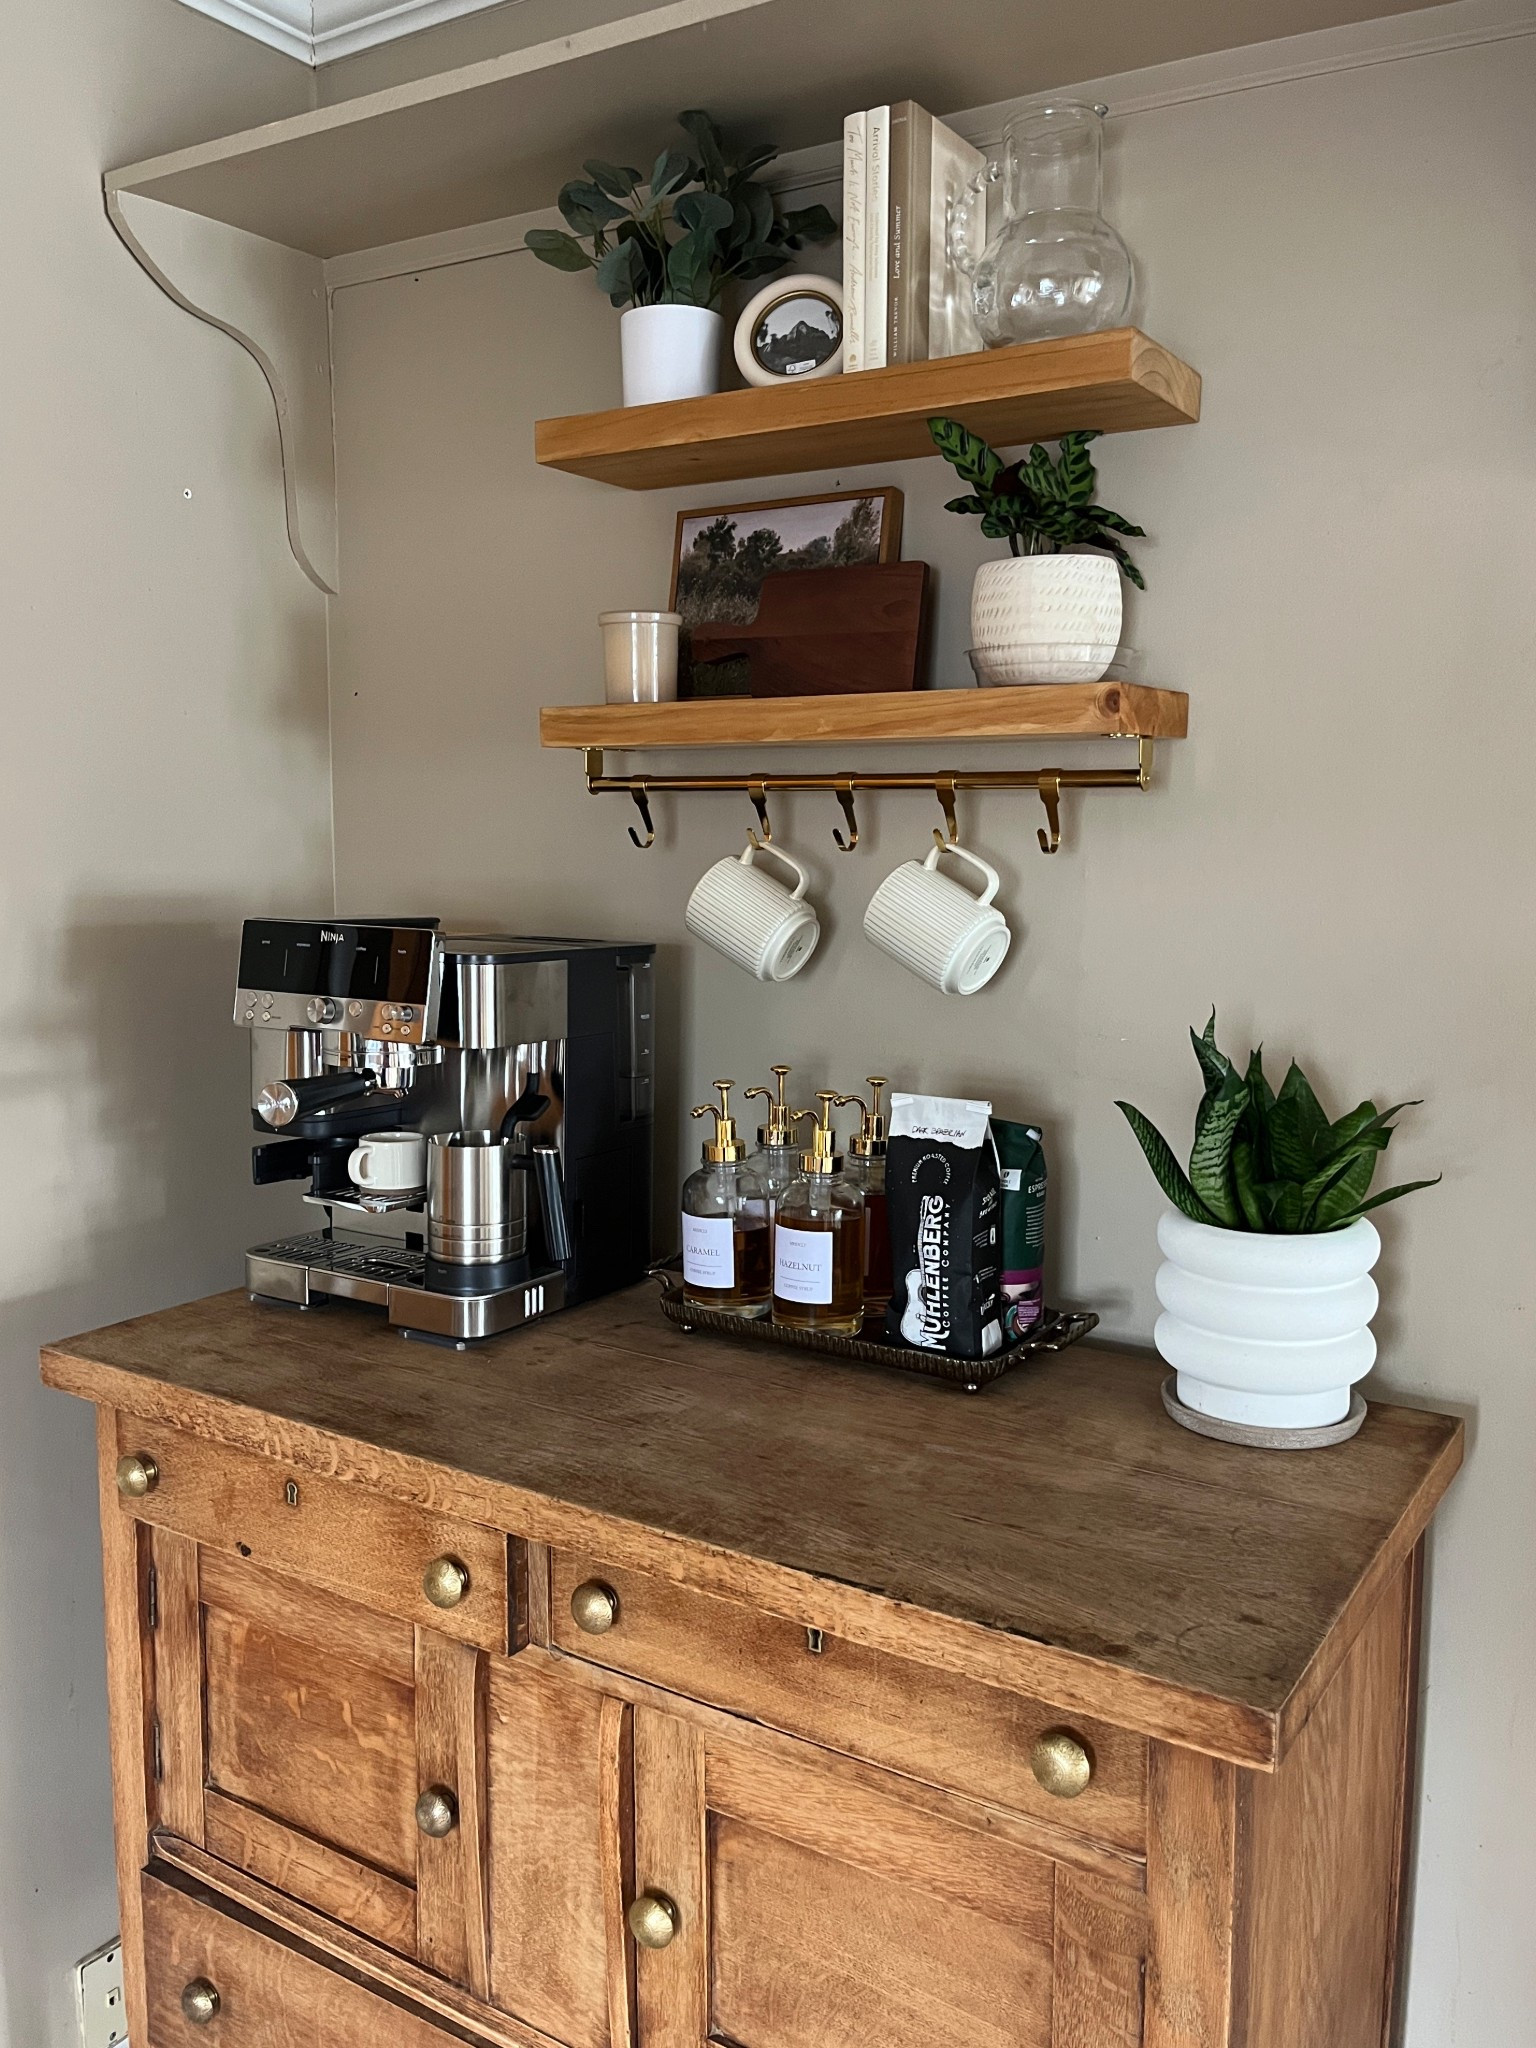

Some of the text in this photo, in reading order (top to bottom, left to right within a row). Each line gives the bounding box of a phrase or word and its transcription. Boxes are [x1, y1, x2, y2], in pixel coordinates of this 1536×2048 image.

[871, 127, 881, 161] Arrival
[871, 164, 881, 202] Stories
[847, 191, 862, 211] Not
[893, 205, 902, 279] Love and Summer
[320, 930, 344, 943] NINJA
[687, 1245, 720, 1257] CARAMEL
[780, 1258, 822, 1272] HAZELNUT
[941, 1203, 951, 1328] COFFEE COMPANY
[919, 1195, 950, 1350] MUHLENBERG
